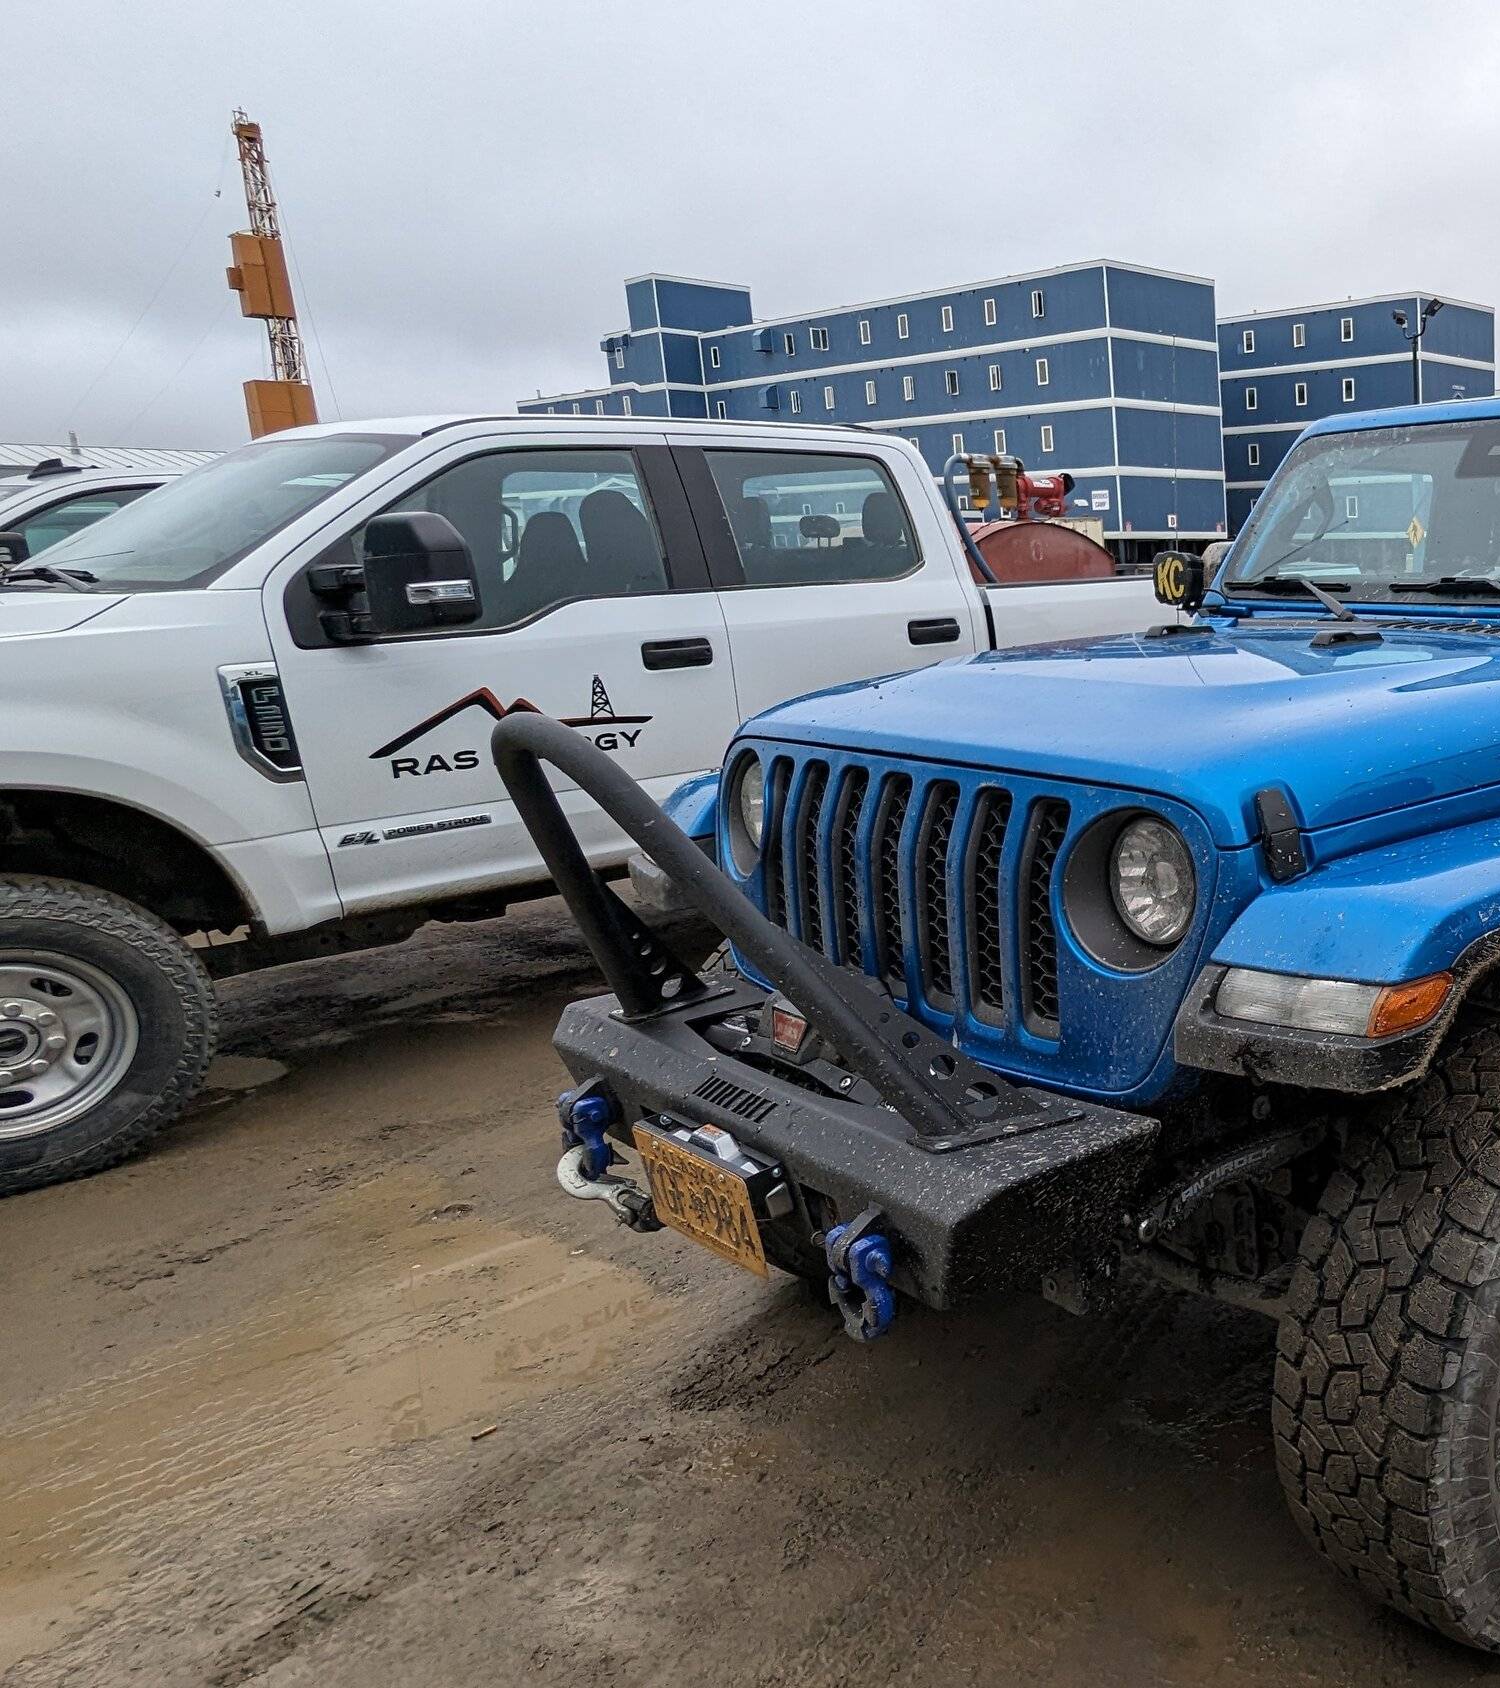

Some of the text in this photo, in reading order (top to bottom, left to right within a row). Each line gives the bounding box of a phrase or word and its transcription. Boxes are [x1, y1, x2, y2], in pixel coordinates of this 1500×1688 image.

[1158, 557, 1184, 600] KC
[391, 750, 480, 778] RAS
[387, 814, 488, 837] POWER STROKE
